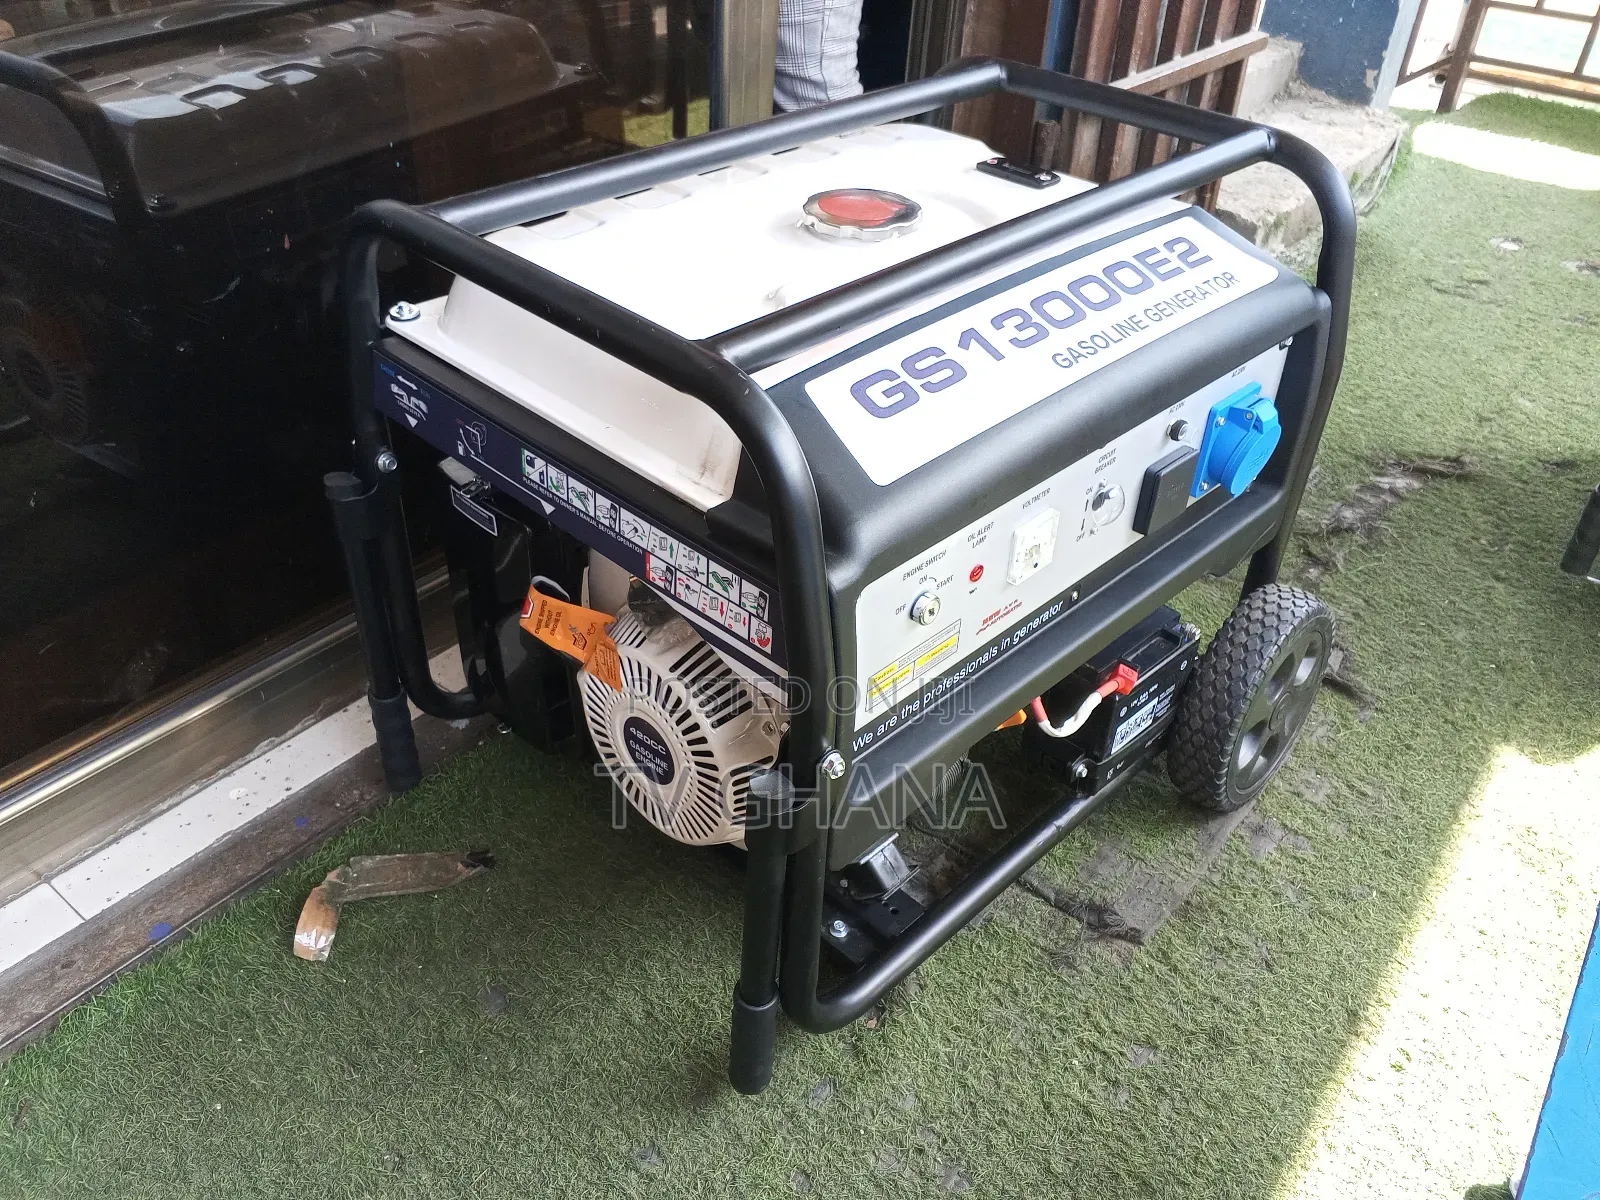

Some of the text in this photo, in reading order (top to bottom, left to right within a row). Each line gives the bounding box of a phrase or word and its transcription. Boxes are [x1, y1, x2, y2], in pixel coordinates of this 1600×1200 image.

[850, 236, 1213, 419] GS13000E2
[1051, 271, 1241, 369] GASOLINE GENERATOR
[580, 512, 598, 528] MANUAL
[976, 521, 995, 537] ALERT
[902, 563, 924, 581] ENGINE
[919, 575, 928, 585] ON
[936, 574, 954, 591] START
[895, 603, 907, 615] OFF
[852, 732, 874, 752] We
[877, 715, 898, 737] are
[901, 699, 920, 720] the
[923, 645, 998, 708] professionals
[1001, 637, 1011, 651] in
[1013, 600, 1064, 645] generator
[629, 727, 666, 755] 420CC
[630, 740, 669, 771] GASOLINE
[635, 751, 665, 776] ENGINE
